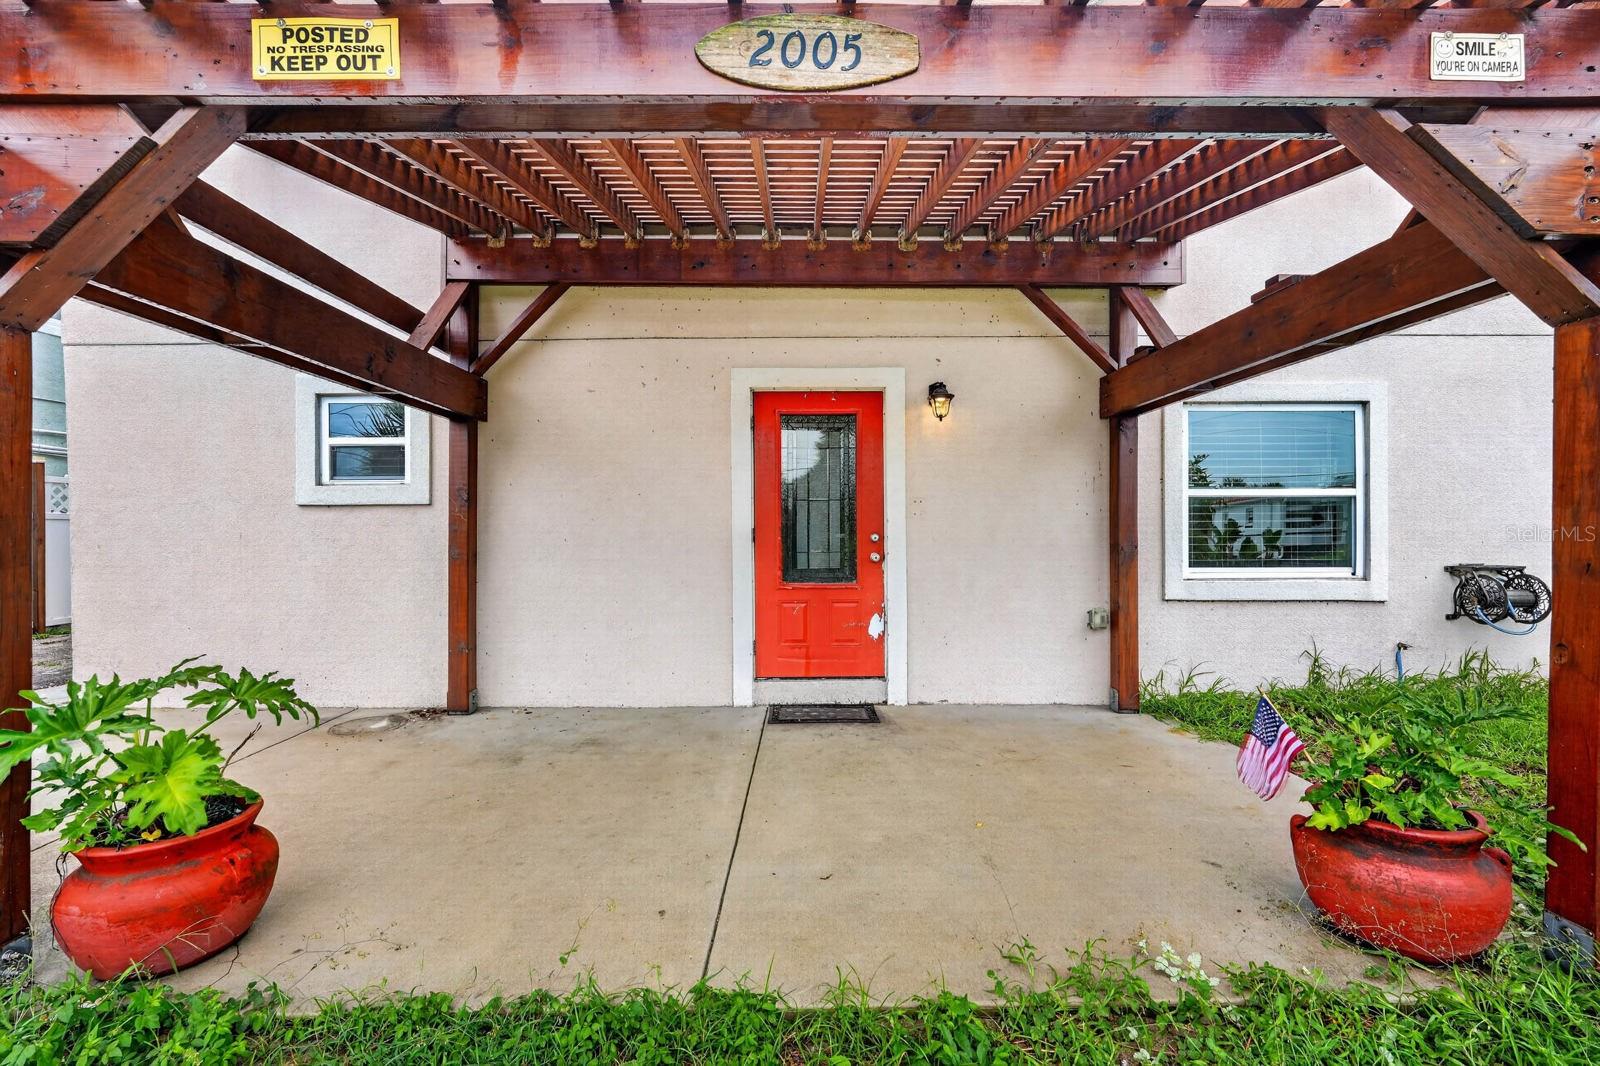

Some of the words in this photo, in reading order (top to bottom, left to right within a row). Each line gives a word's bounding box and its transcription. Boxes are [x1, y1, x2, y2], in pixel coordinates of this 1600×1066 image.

[281, 26, 370, 44] POSTED
[266, 46, 286, 54] NO
[290, 44, 385, 54] TRESPASSING
[748, 29, 863, 72] 2005
[1455, 41, 1496, 57] SMILE
[270, 54, 328, 72] KEEP
[336, 54, 382, 71] OUT
[1435, 60, 1465, 72] YOU'RE
[1467, 61, 1480, 72] ON
[1481, 61, 1519, 73] CAMERA
